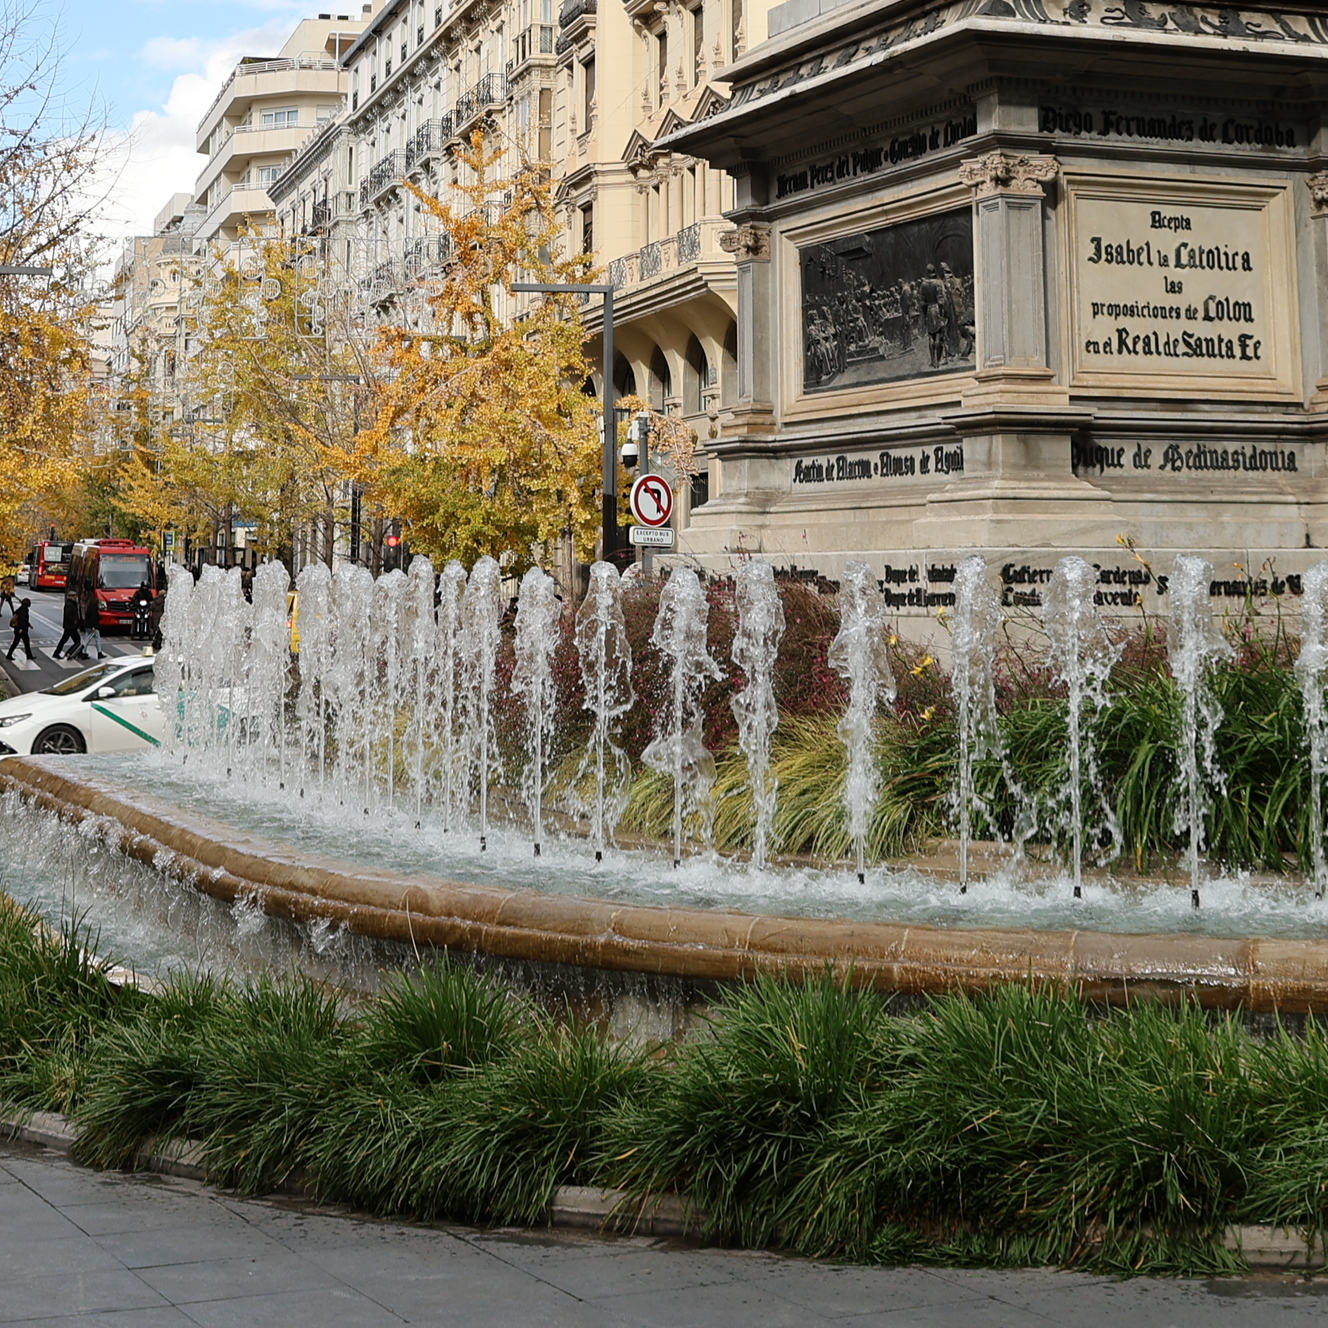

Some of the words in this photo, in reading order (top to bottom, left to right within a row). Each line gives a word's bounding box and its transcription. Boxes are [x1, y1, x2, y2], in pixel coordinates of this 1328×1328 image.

[929, 124, 940, 151] de
[1039, 106, 1093, 137] Diego
[1199, 117, 1218, 143] de
[1221, 118, 1297, 148] Cordoba
[1150, 210, 1192, 233] Acepta
[1087, 236, 1154, 267] Isabel
[1157, 250, 1170, 268] la
[1174, 242, 1253, 272] Catolica
[1164, 276, 1183, 294] las
[1091, 301, 1181, 320] proposiciones
[1185, 304, 1199, 321] de
[1202, 294, 1255, 323] Colon
[1085, 339, 1101, 354] en
[1103, 337, 1114, 355] el
[1115, 327, 1162, 356] Real
[1163, 332, 1180, 358] de
[1181, 330, 1236, 360] Santa
[1237, 333, 1262, 361] Fe
[825, 457, 835, 482] de
[919, 449, 931, 475] de
[1132, 442, 1152, 470] de
[1158, 442, 1298, 472] Medinasidonia
[1002, 563, 1053, 584] Gutierr
